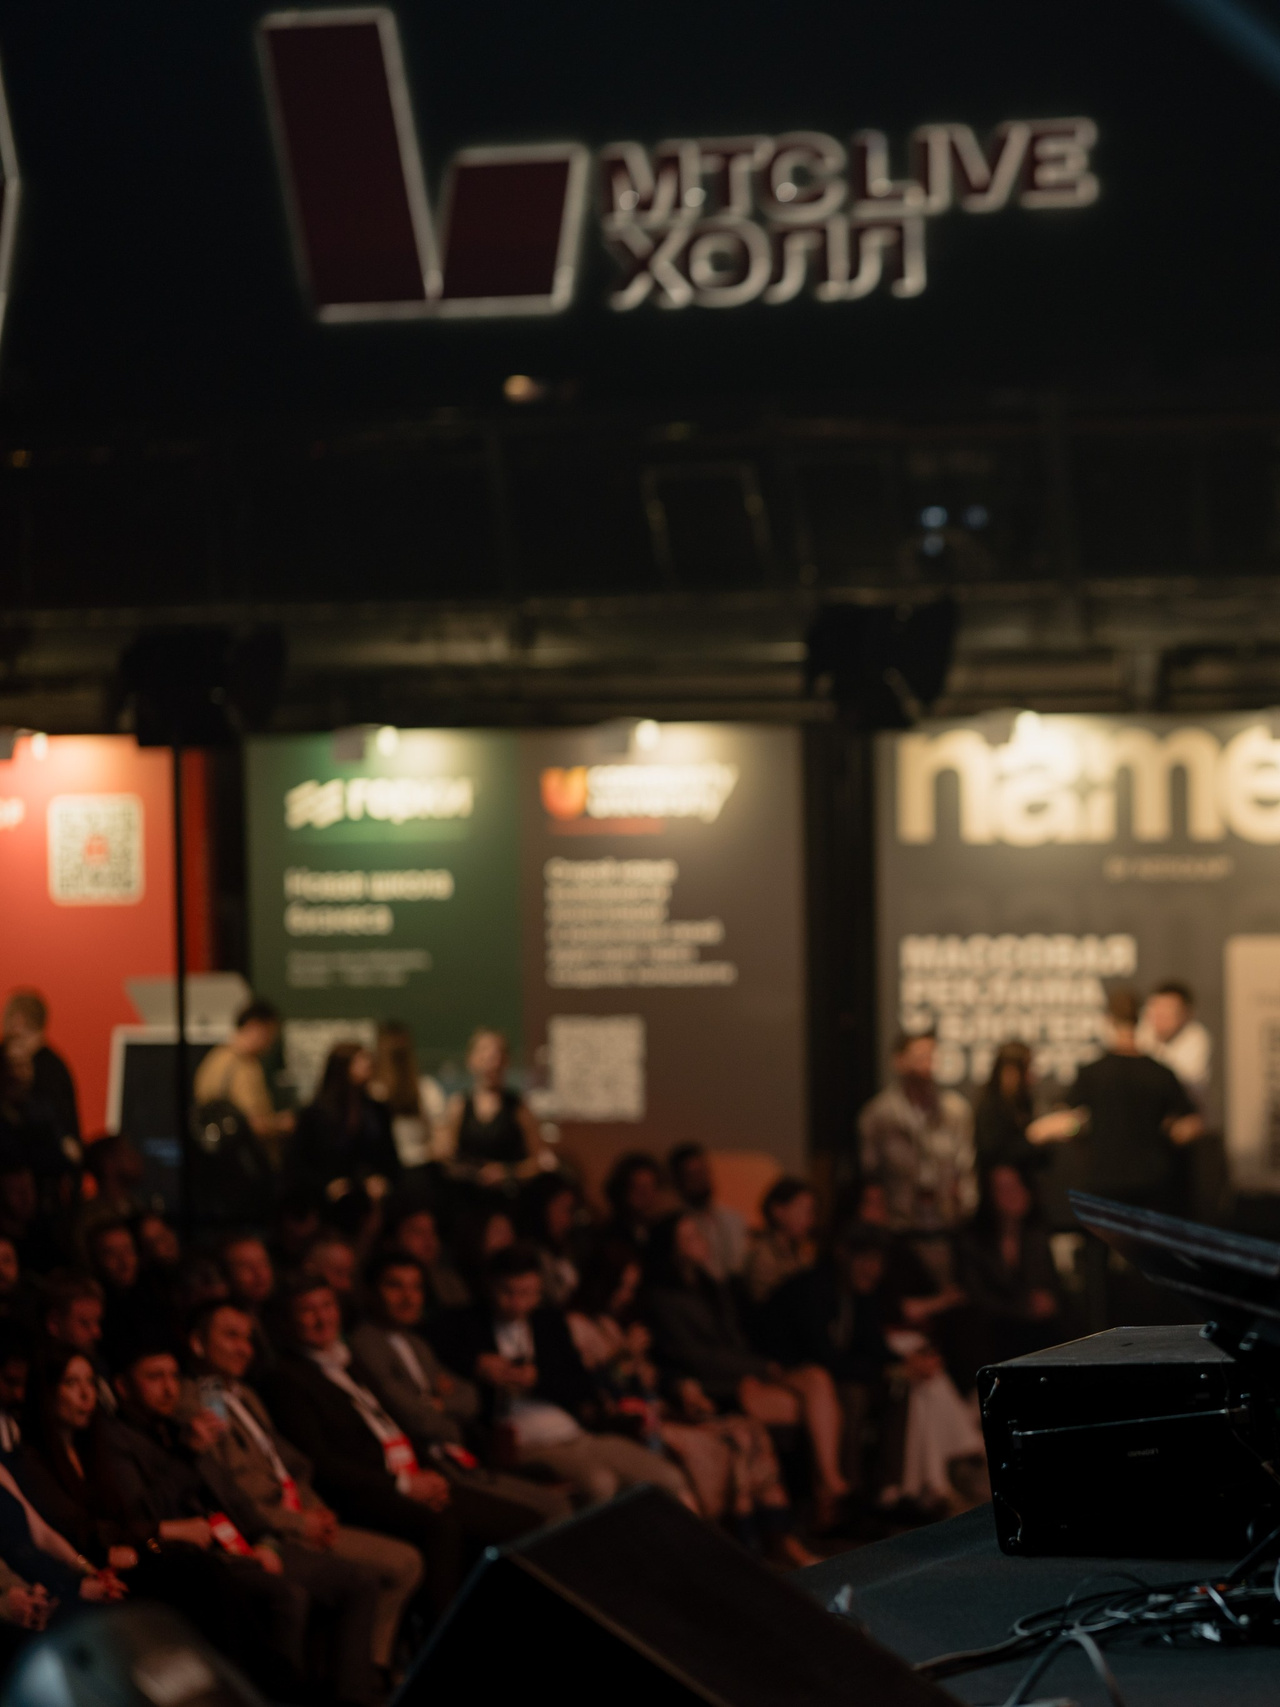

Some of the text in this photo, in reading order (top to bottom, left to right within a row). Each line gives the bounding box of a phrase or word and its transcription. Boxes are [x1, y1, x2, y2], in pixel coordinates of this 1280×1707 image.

[599, 119, 1097, 222] МТС LIVE
[606, 214, 926, 310] ХОЛЛ
